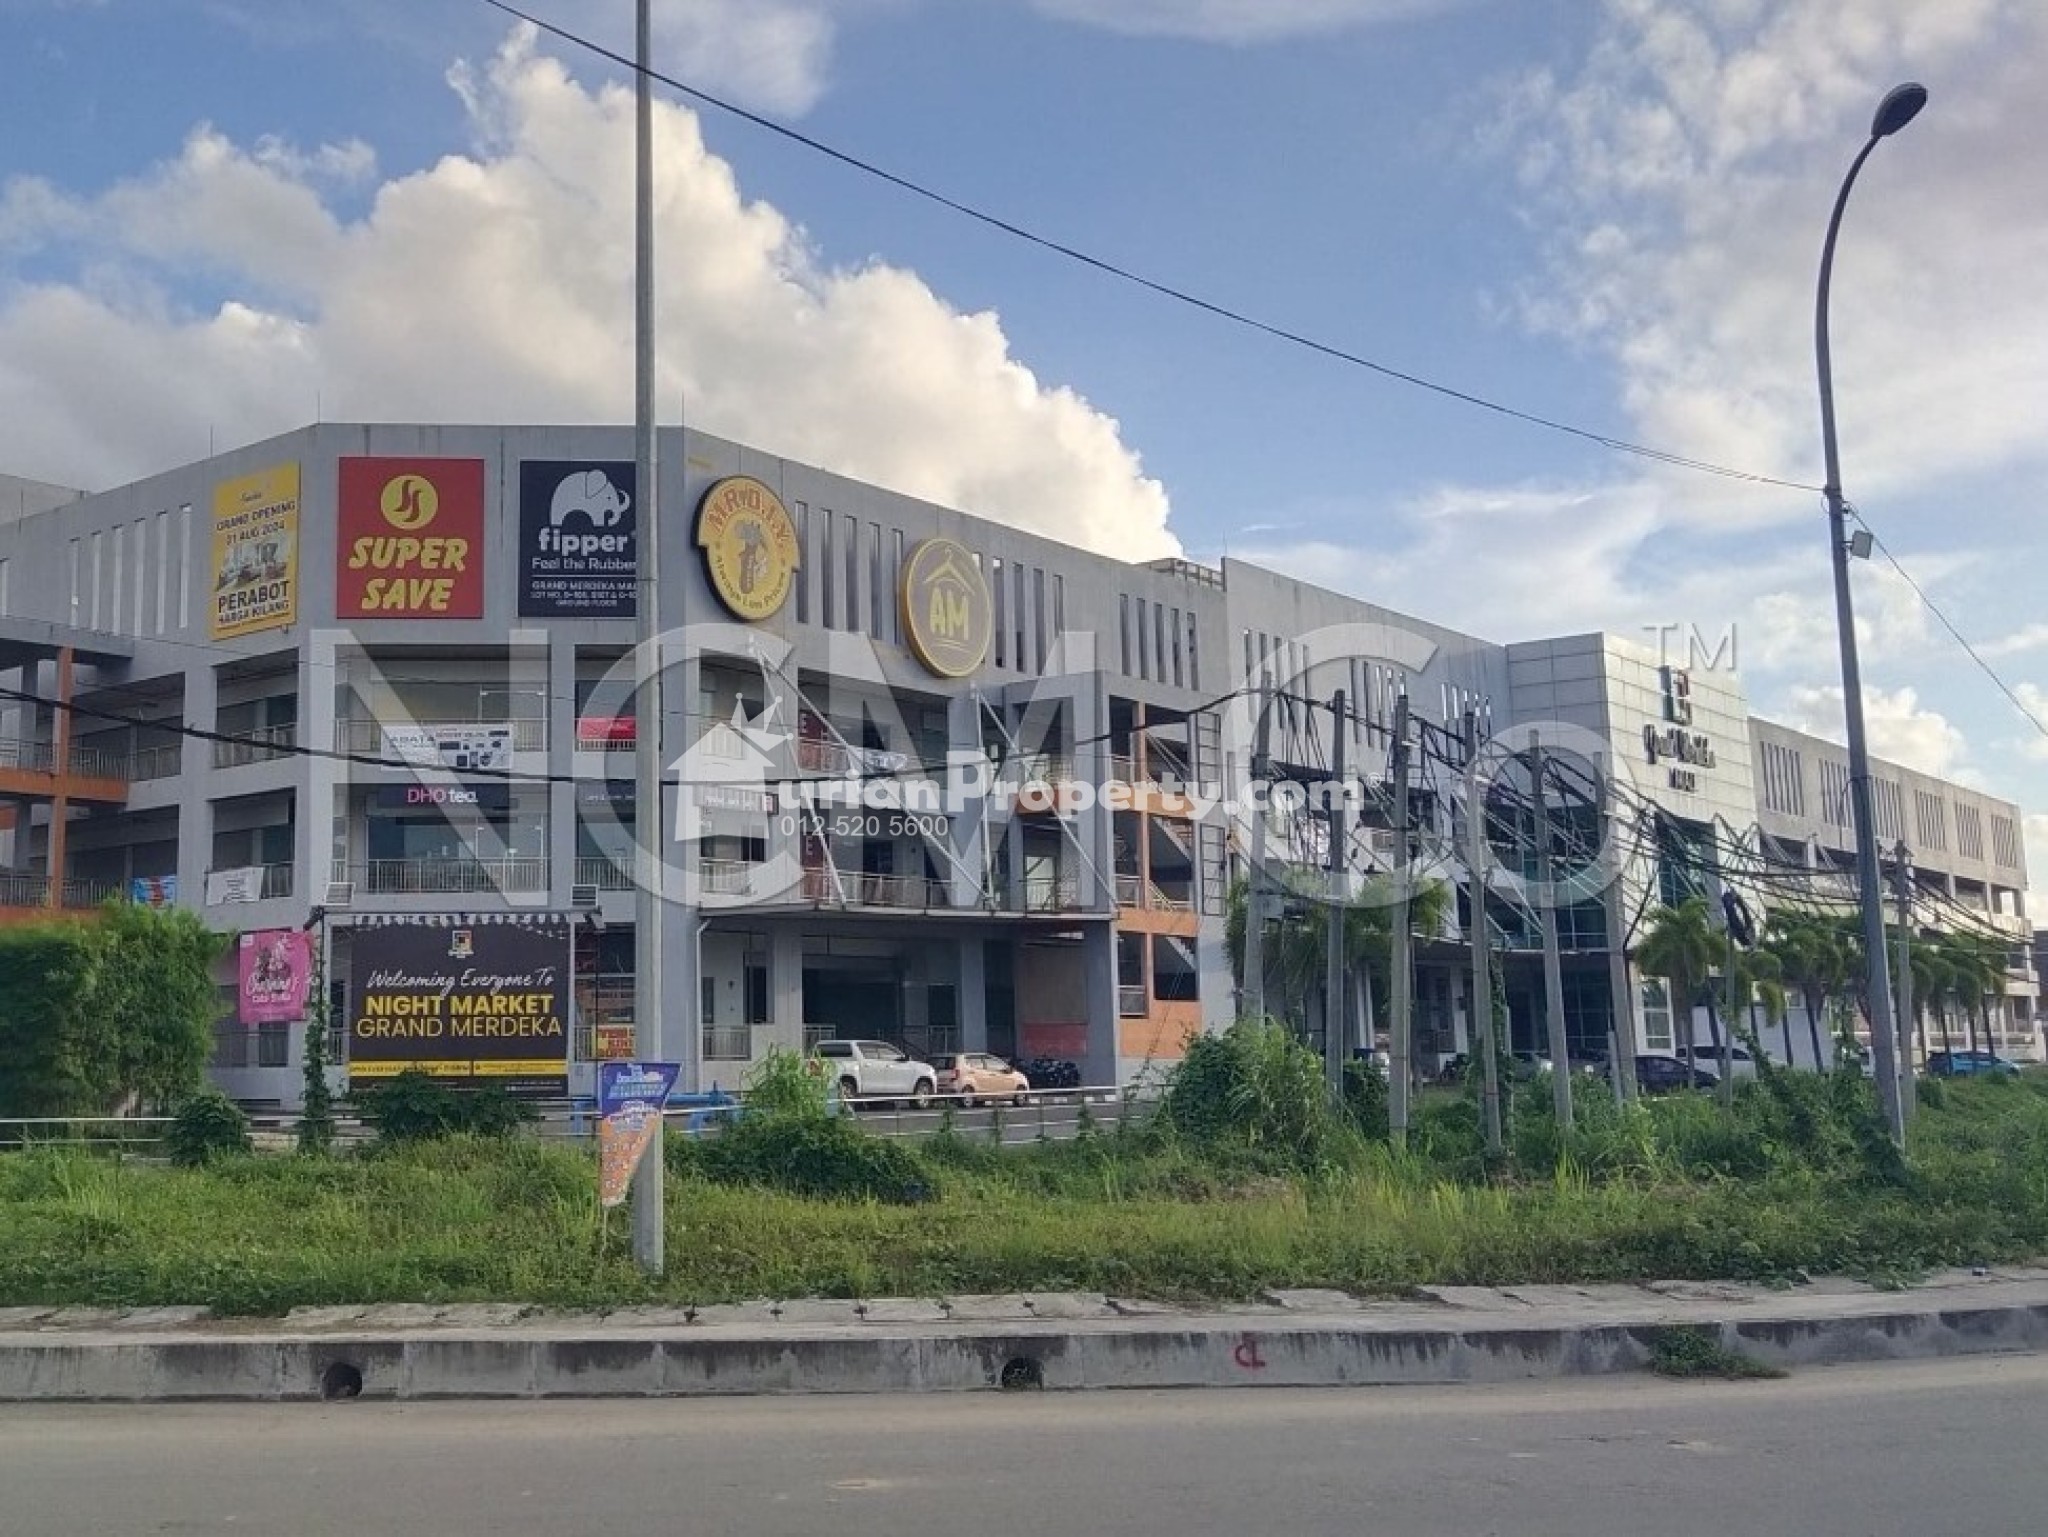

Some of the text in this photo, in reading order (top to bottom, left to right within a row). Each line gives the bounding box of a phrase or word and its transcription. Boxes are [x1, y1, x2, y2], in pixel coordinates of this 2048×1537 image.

[216, 500, 296, 531] GRAND OPENING
[239, 527, 260, 542] AUG
[539, 527, 628, 556] fipper
[348, 537, 468, 572] SUPER
[531, 557, 560, 570] Feel
[563, 557, 586, 570] the
[218, 580, 290, 613] PERABOT
[361, 578, 455, 610] SAVE
[930, 586, 969, 642] AM
[366, 966, 556, 1001] Welcoming Everyone To
[365, 994, 554, 1016] NIGHT MARKET
[356, 1016, 563, 1038] GRAND MERDEKA
